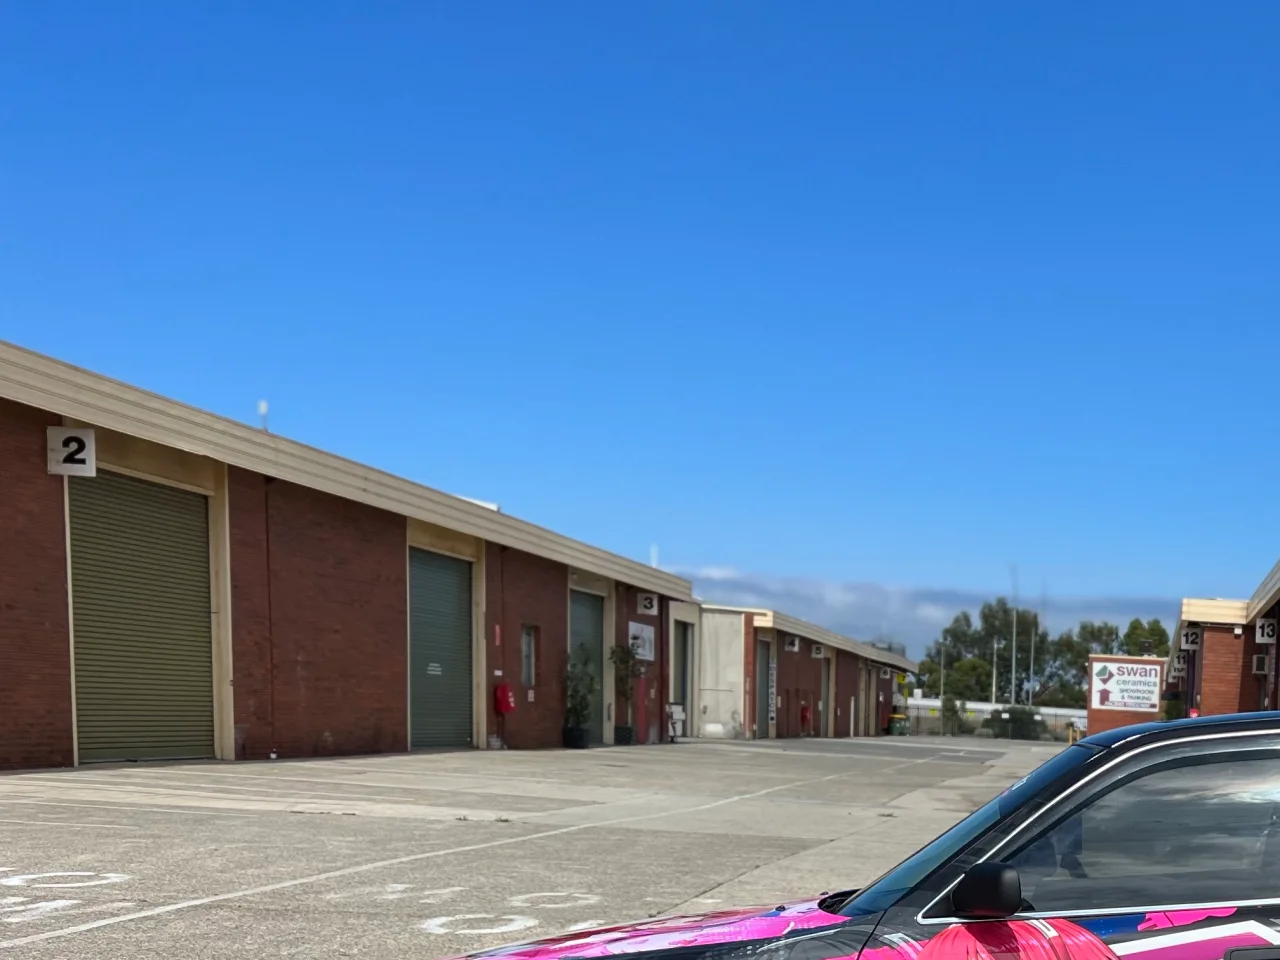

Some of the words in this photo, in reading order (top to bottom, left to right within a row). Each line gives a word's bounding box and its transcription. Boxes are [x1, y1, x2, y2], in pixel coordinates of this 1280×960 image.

[62, 435, 87, 465] 2
[643, 597, 654, 610] 3
[1258, 622, 1276, 639] 13
[788, 638, 796, 648] 4
[1183, 631, 1199, 645] 12
[814, 645, 823, 655] 5
[1176, 654, 1186, 665] 11
[882, 667, 889, 676] 6
[1116, 665, 1158, 678] swan
[1116, 680, 1158, 688] ceramics
